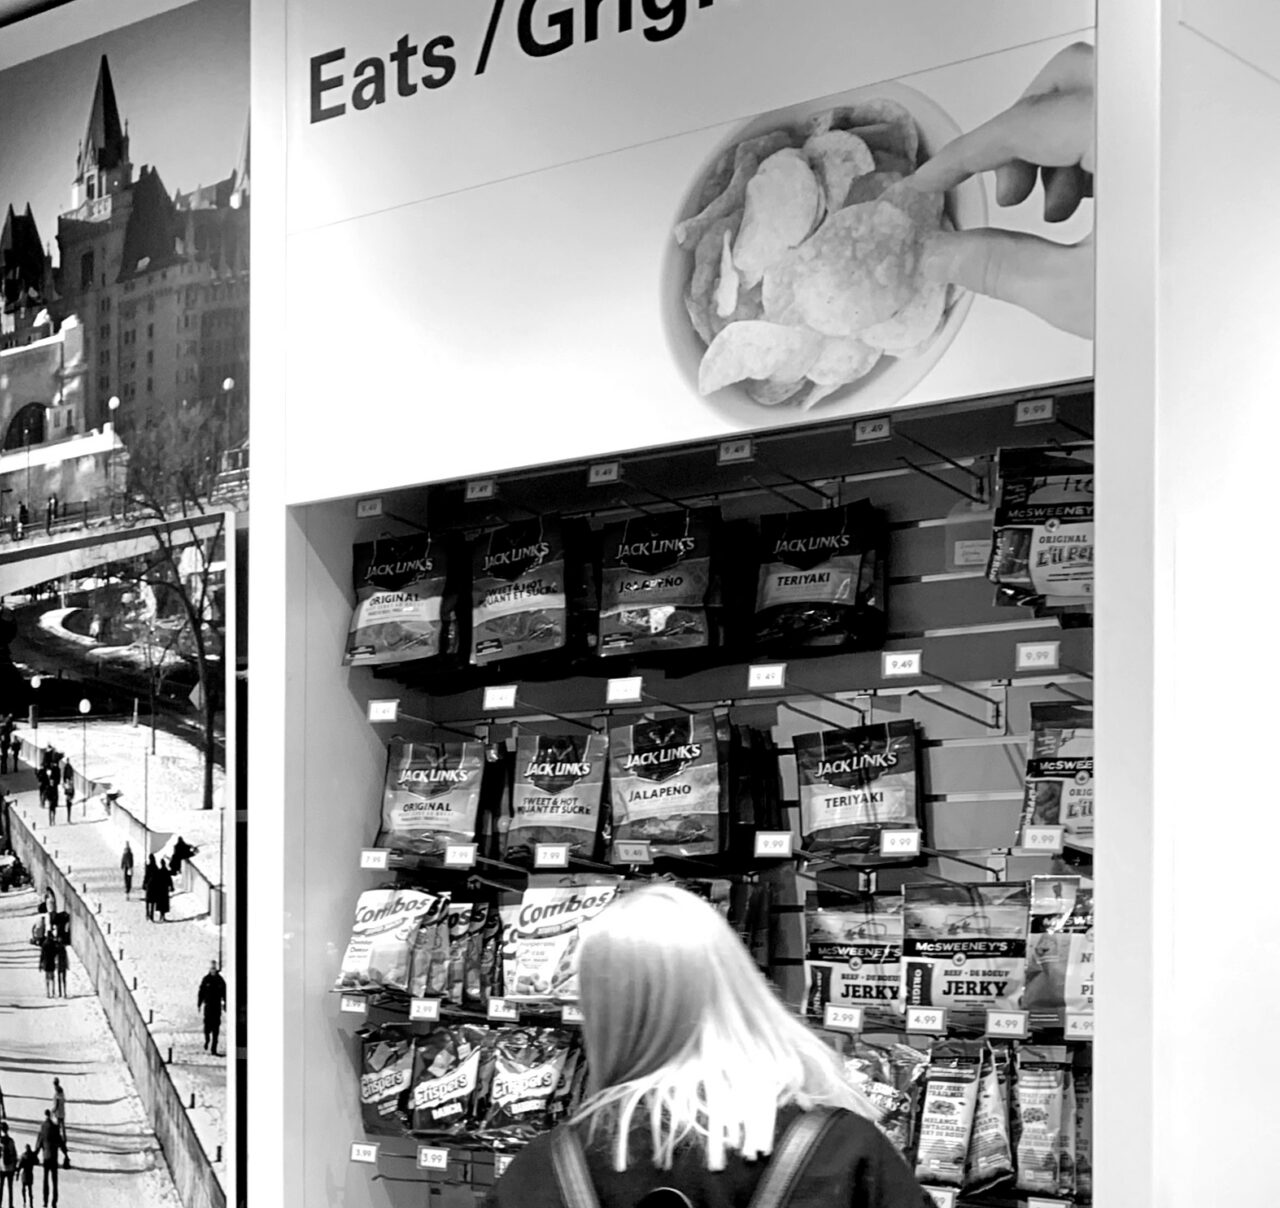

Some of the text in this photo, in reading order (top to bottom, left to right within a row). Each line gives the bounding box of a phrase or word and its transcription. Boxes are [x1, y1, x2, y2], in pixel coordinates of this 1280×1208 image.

[310, 33, 456, 124] Eats
[1023, 404, 1046, 414] 9.99
[860, 423, 883, 434] 9.49
[1008, 506, 1094, 518] McSWEENEY
[1039, 535, 1087, 545] ORIGINAL
[616, 543, 649, 559] JACK
[773, 539, 806, 554] JACK
[482, 552, 510, 570] JACK
[365, 563, 393, 579] JACK
[777, 573, 830, 587] TERIYAKI
[1025, 650, 1049, 661] 9.99
[891, 659, 912, 669] 9.49
[624, 753, 657, 768] JACK
[1040, 760, 1094, 771] McSWEE
[524, 762, 555, 777] JACK
[815, 761, 851, 777] JACK
[398, 769, 428, 783] JACK
[1069, 788, 1094, 797] ORIG
[403, 801, 452, 812] ORIGINAL
[825, 792, 883, 809] TERIYAKI
[763, 840, 784, 849] 9.99
[890, 838, 911, 846] 9.99
[1031, 834, 1054, 844] 9.99
[356, 896, 432, 925] Combos
[520, 891, 609, 928] Combos
[819, 946, 901, 957] McSWEENEY'S
[915, 941, 1008, 952] McSWEENEY'S
[841, 983, 899, 1000] JERKY
[942, 981, 1008, 997] JERKY
[833, 1013, 854, 1023] 2.99
[914, 1015, 937, 1025] 4.99
[994, 1019, 1018, 1029] 4.99
[361, 1071, 404, 1099] Crispers
[414, 1074, 468, 1106] Crispers
[422, 1153, 442, 1164] 3.99
